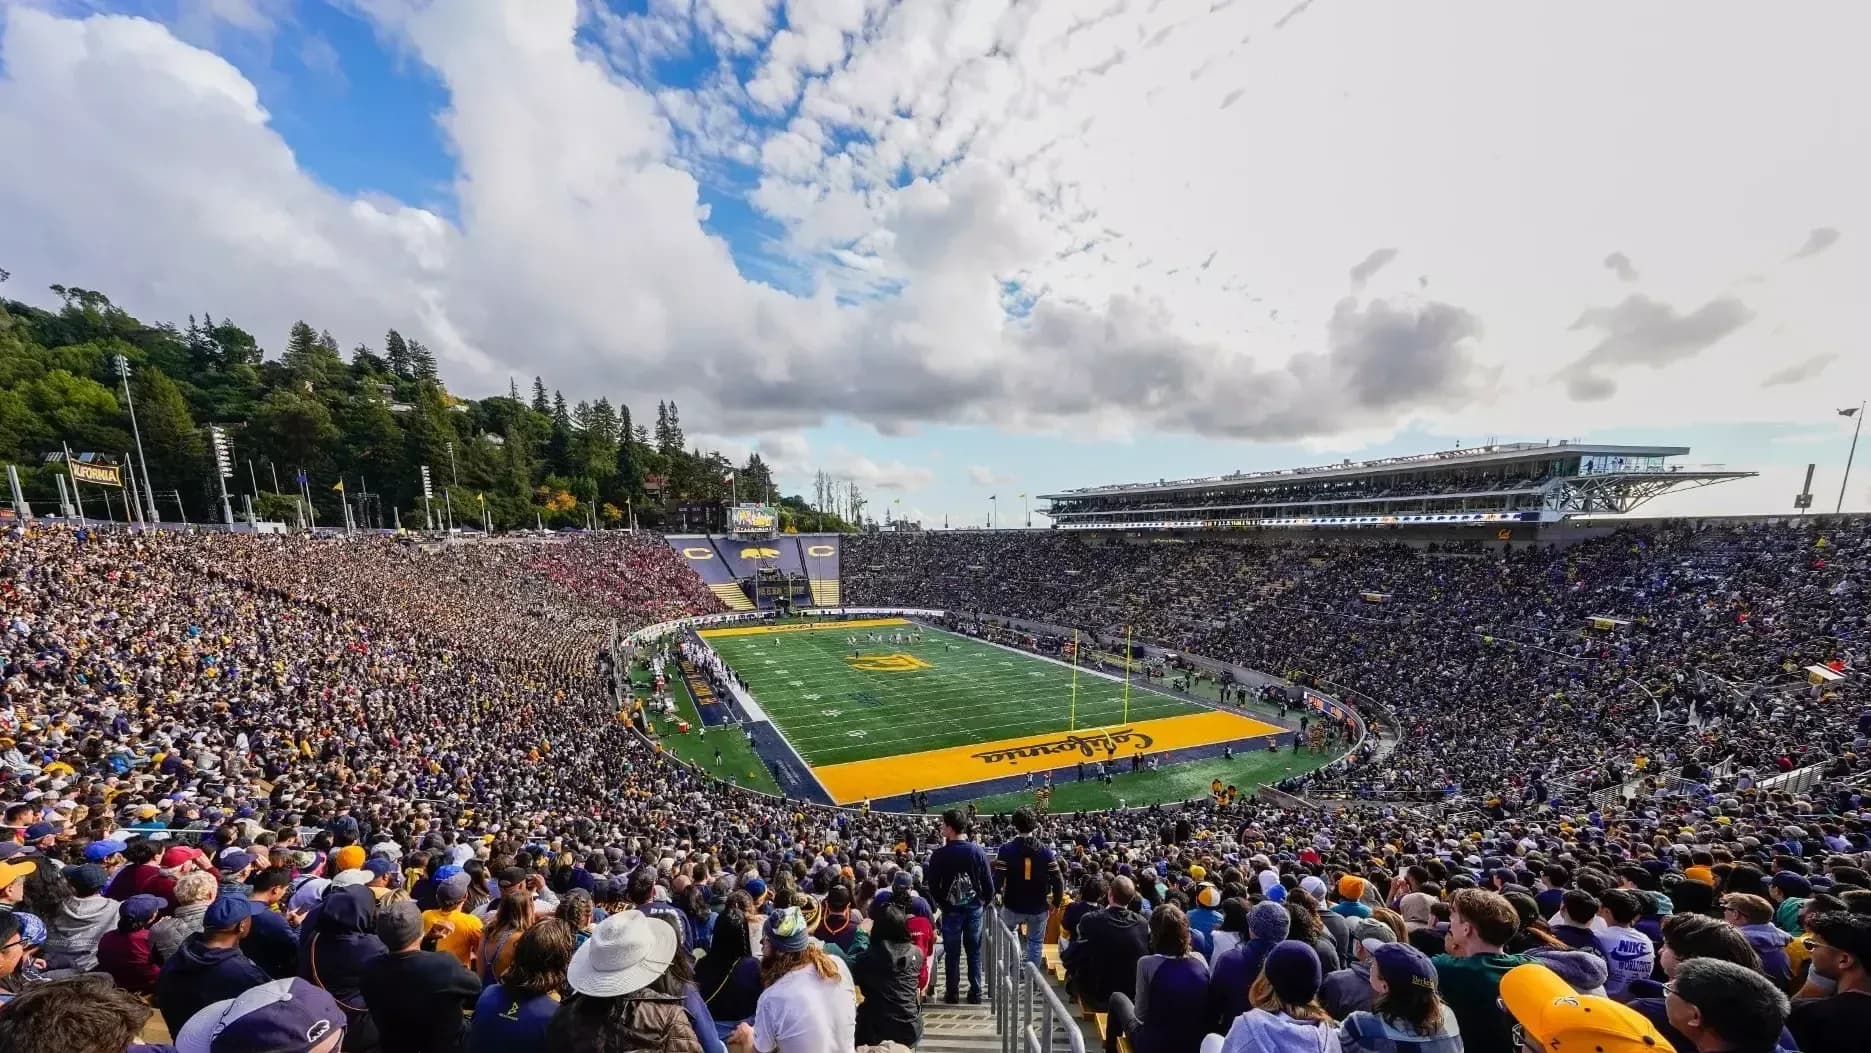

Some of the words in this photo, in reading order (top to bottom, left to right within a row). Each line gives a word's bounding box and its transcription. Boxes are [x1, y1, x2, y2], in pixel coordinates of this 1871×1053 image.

[682, 547, 714, 560] C
[807, 545, 835, 557] C
[970, 728, 1154, 765] California
[1024, 856, 1031, 881] 1
[1618, 940, 1647, 954] NIKE
